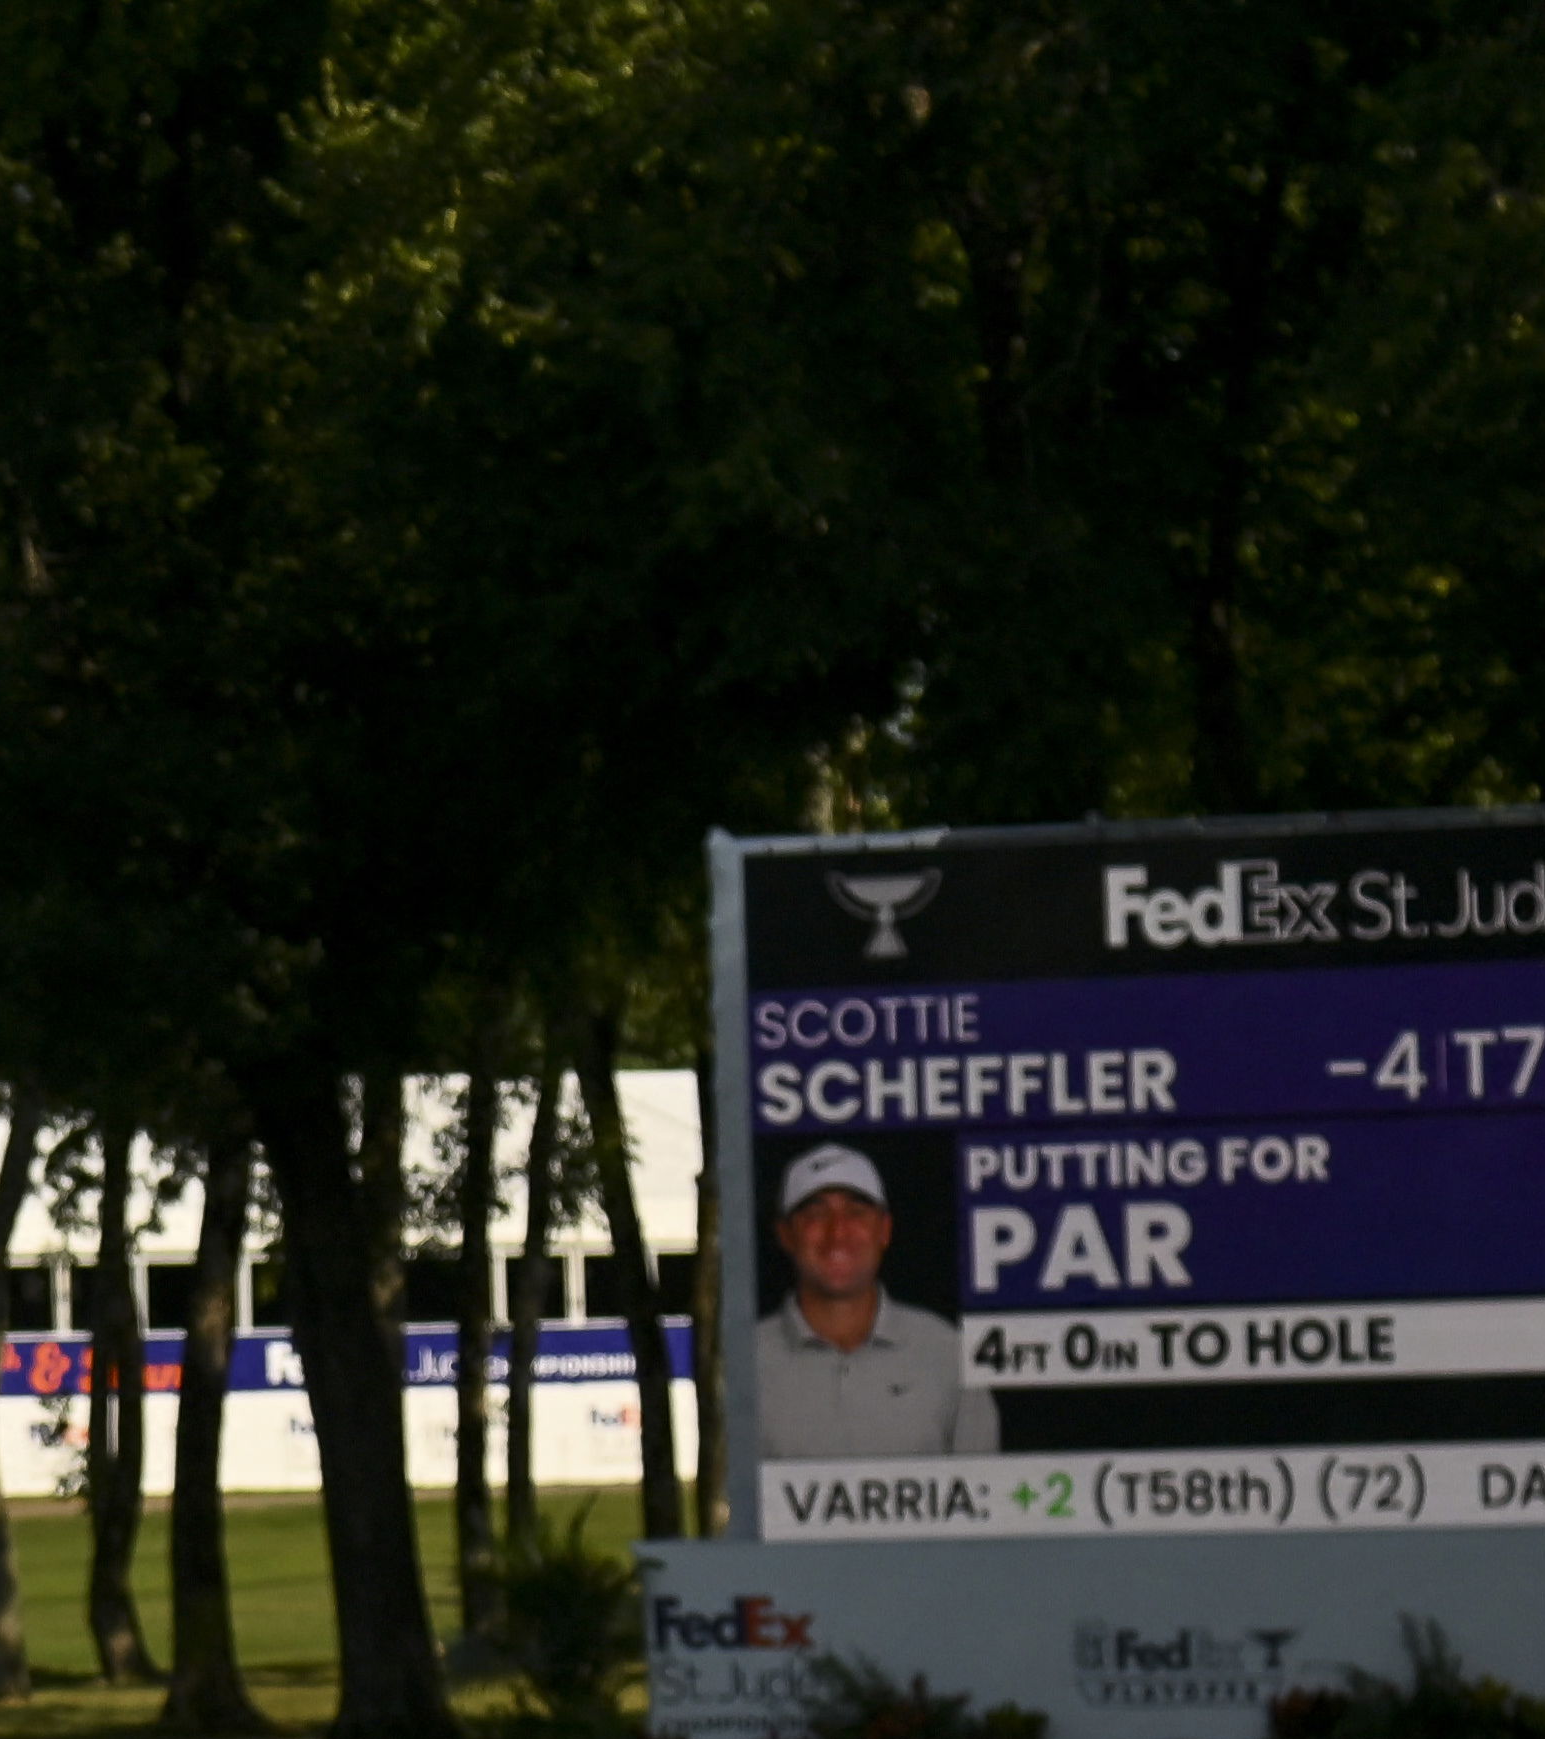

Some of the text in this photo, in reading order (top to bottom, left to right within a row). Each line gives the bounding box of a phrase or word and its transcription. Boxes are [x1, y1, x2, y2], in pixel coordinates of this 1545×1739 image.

[1104, 860, 1339, 948] FedEx
[756, 994, 980, 1048] SCOTTIE
[759, 1048, 1179, 1125] SCHEFFLER
[967, 1135, 1332, 1191] PUTTING FOR
[972, 1201, 1194, 1293] PAR
[974, 1326, 1051, 1374] 4FT
[1150, 1320, 1230, 1369] TO
[1246, 1316, 1397, 1366] HOLE
[784, 1455, 1428, 1525] VARRIA: +2 (T58th) (72)
[655, 1596, 813, 1651] FedEx
